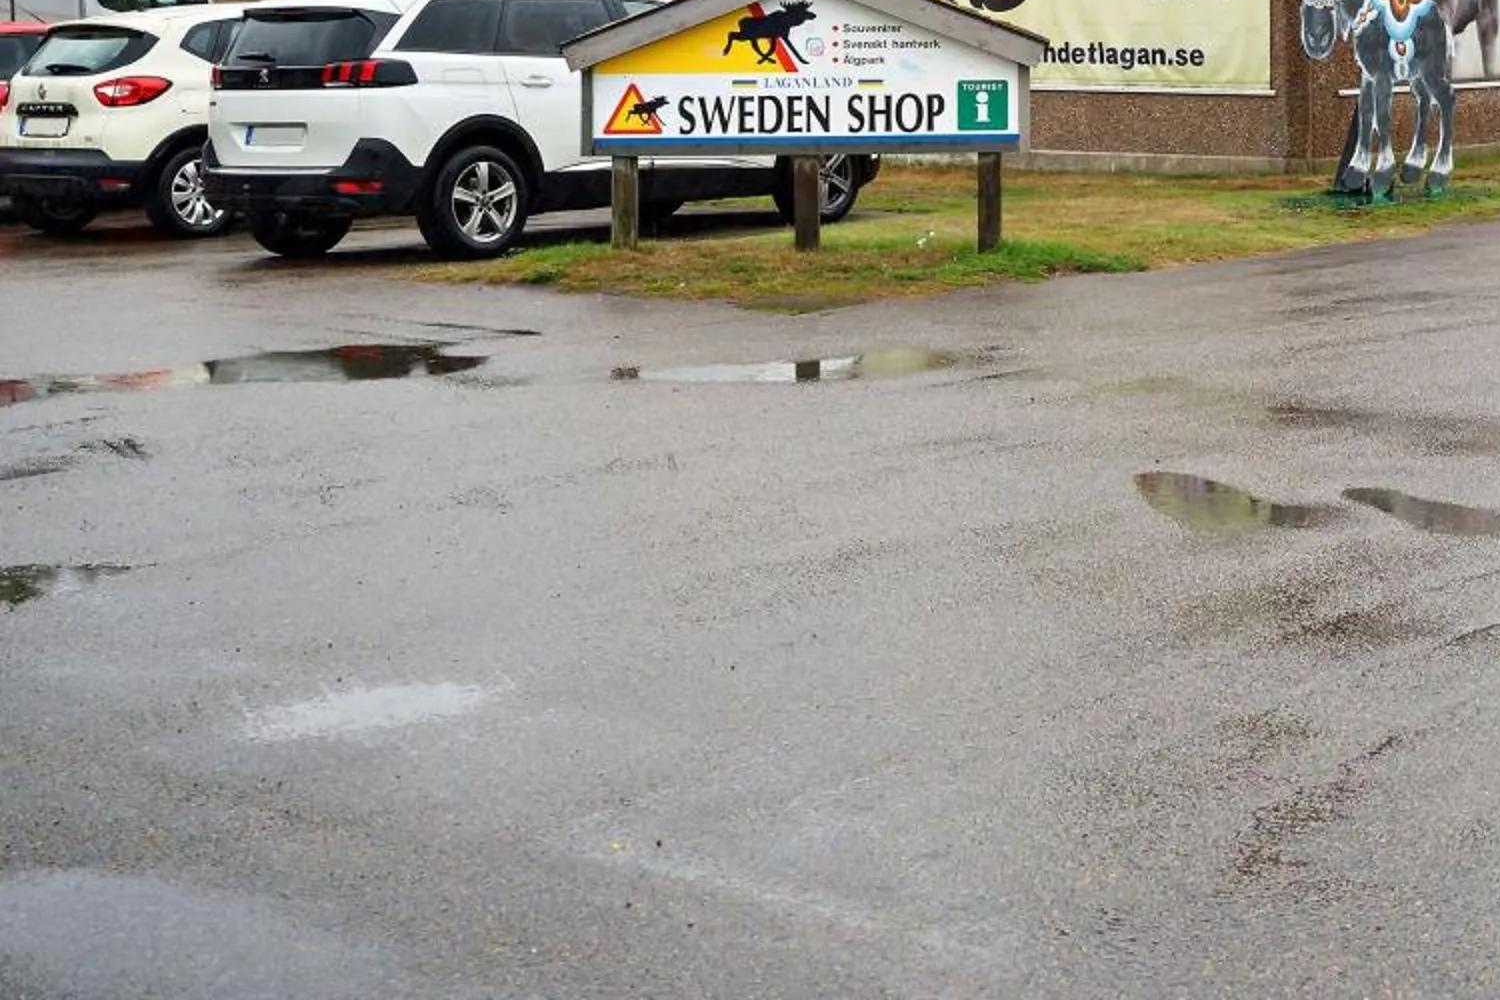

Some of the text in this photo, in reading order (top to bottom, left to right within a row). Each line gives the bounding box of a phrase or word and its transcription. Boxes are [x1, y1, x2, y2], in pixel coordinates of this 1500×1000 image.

[763, 77, 854, 89] LAGANLAND
[678, 93, 945, 135] SWEDEN SHOP
